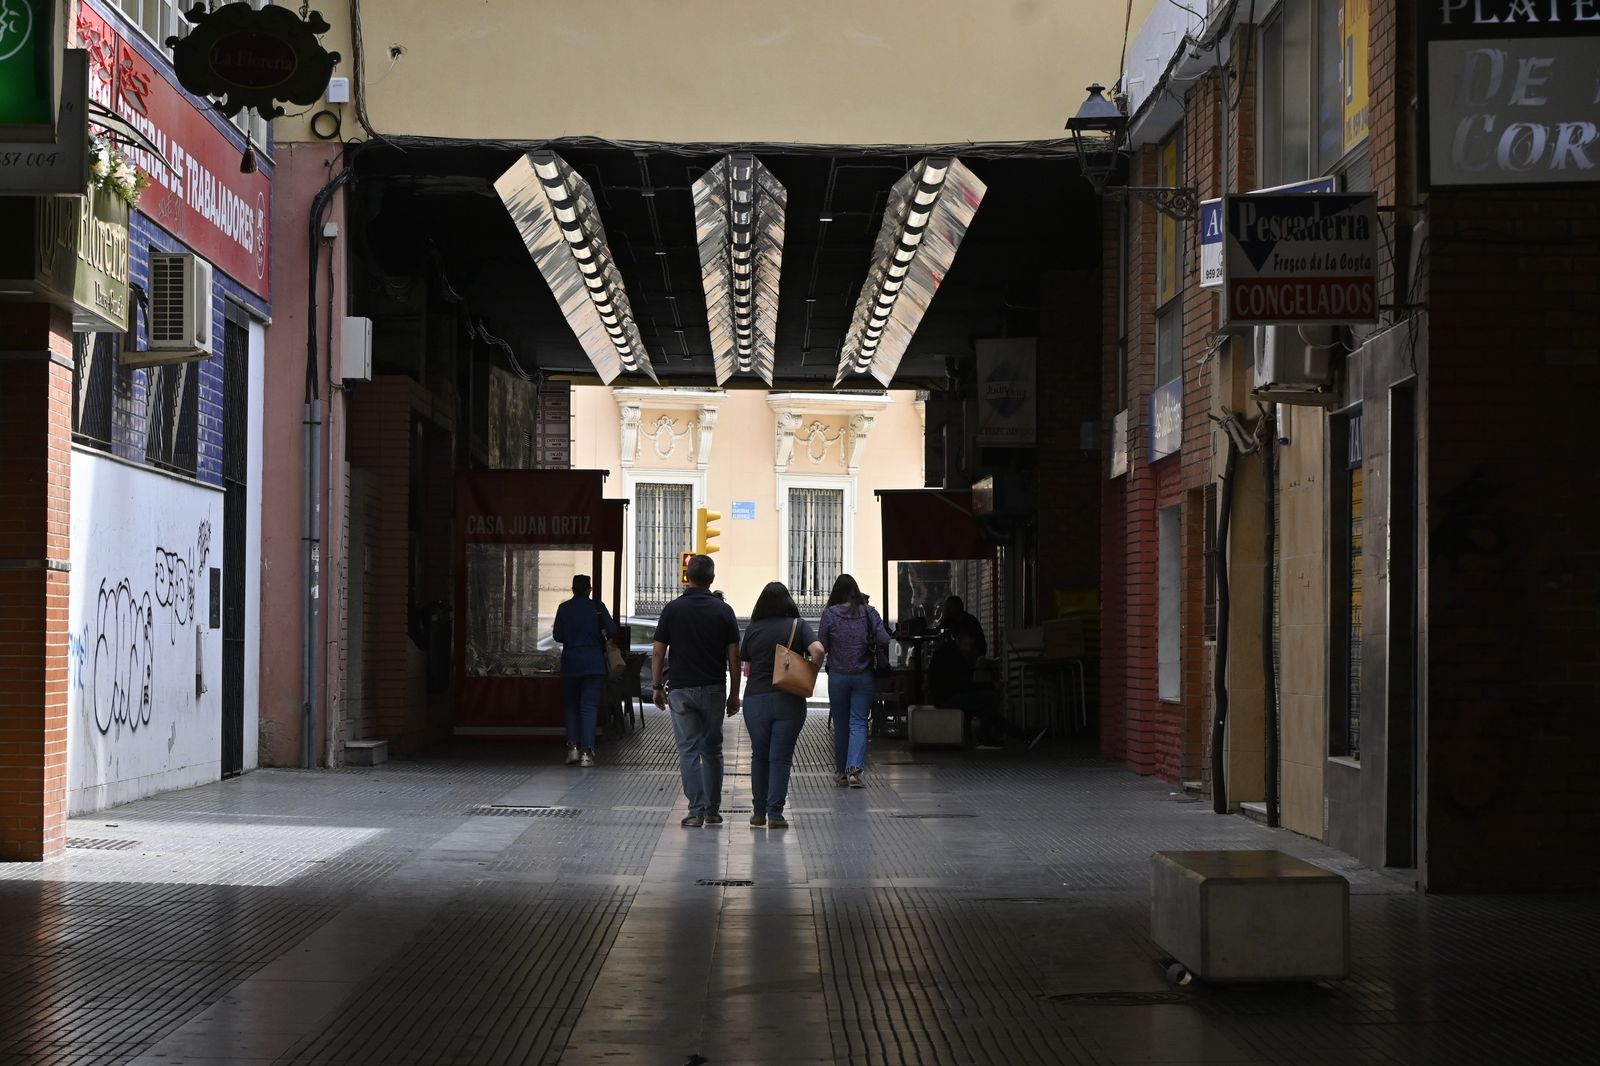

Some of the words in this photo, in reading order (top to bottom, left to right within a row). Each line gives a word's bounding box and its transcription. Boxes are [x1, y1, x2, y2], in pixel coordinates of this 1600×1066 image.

[214, 48, 232, 65] La
[1454, 48, 1555, 107] DE
[0, 151, 22, 167] 87
[171, 139, 184, 200] DE
[185, 152, 254, 254] TRABAJADORES
[1273, 253, 1307, 273] Fresco
[1309, 252, 1322, 271] de
[1340, 252, 1372, 273] Costa
[1205, 269, 1216, 280] 959
[1234, 282, 1373, 317] CONGELADOS
[466, 514, 504, 535] CASA
[508, 514, 547, 535] JUAN
[551, 514, 592, 535] ORTIZ
